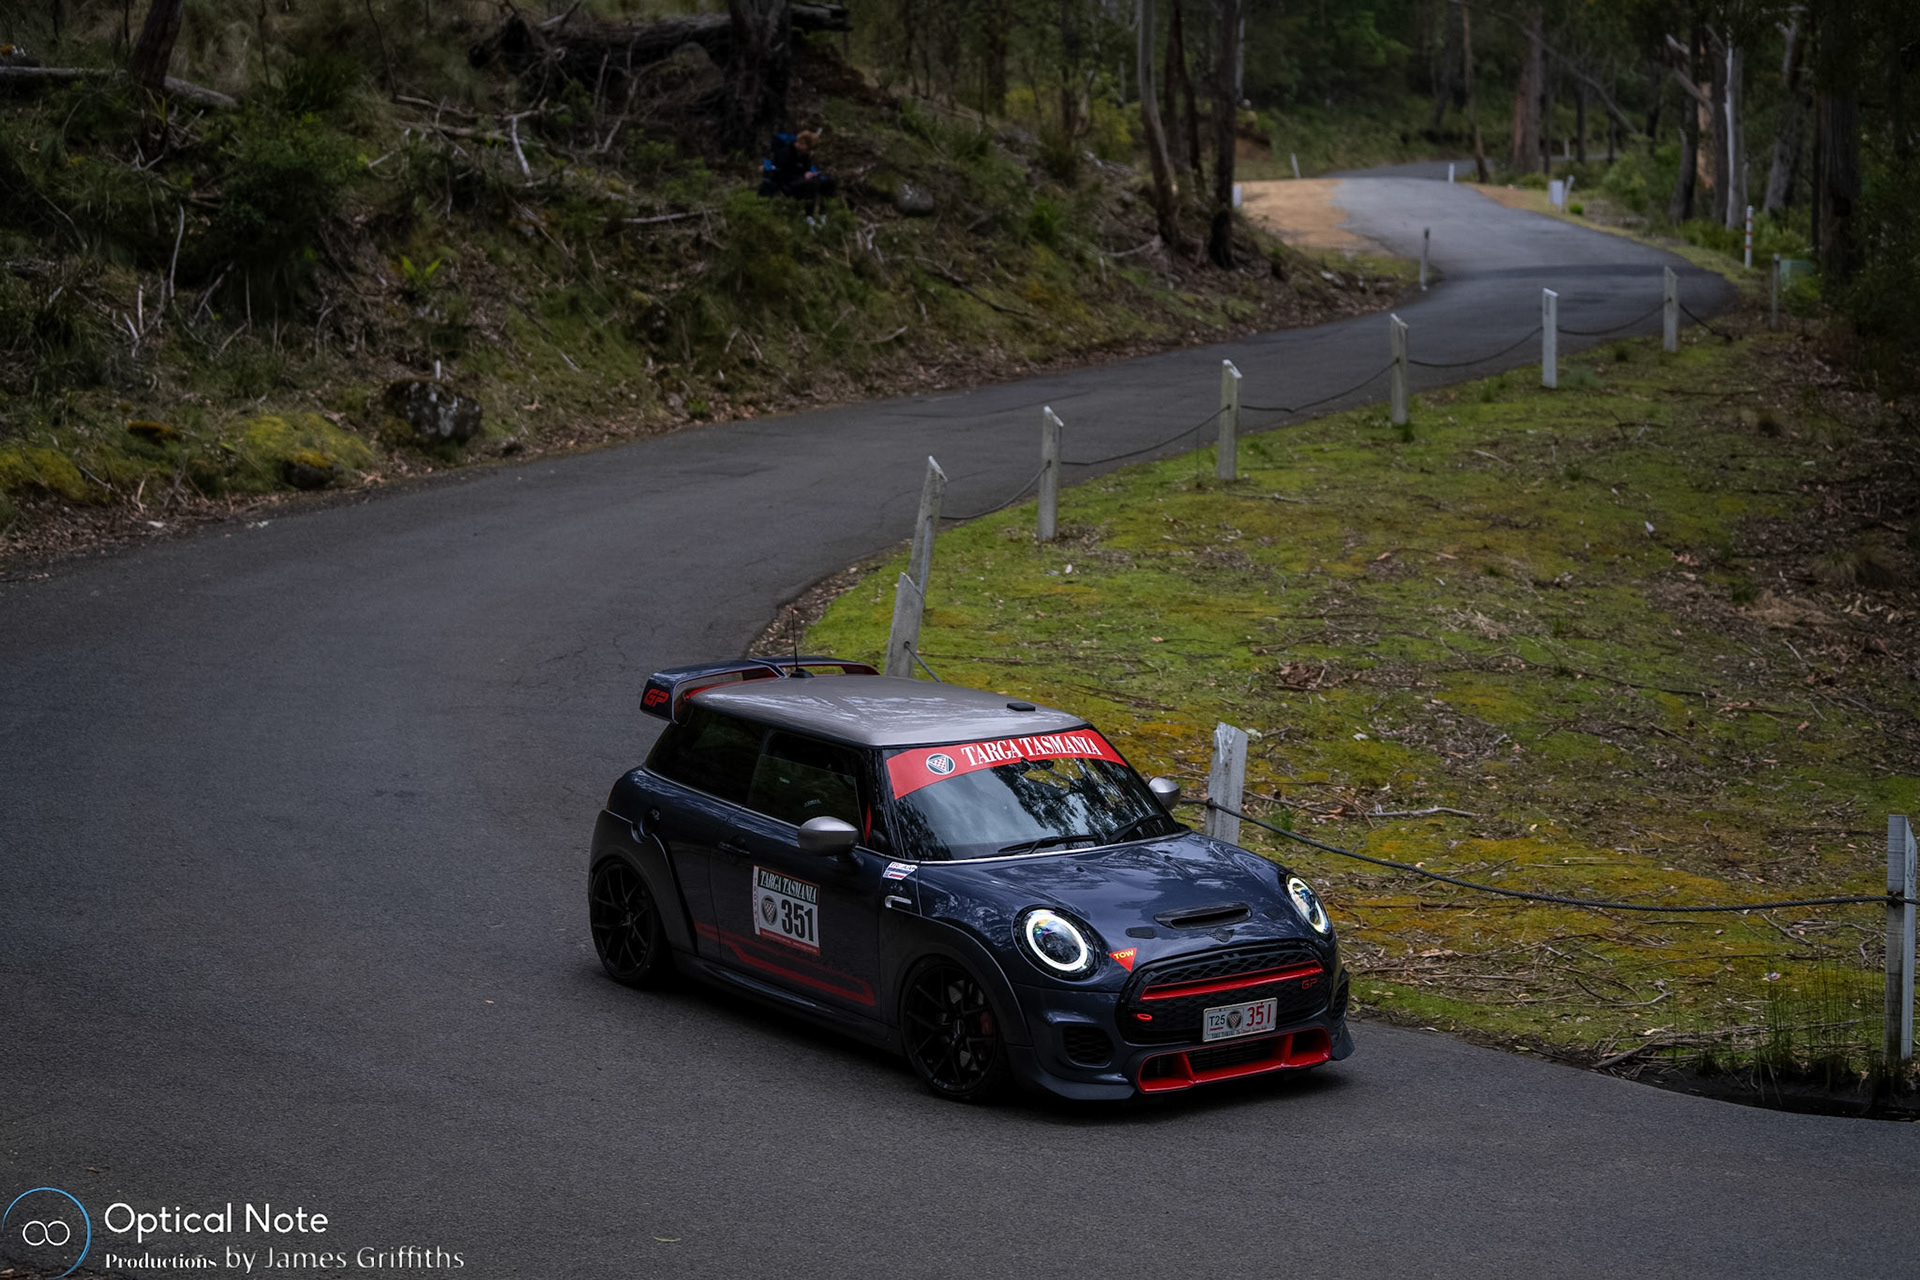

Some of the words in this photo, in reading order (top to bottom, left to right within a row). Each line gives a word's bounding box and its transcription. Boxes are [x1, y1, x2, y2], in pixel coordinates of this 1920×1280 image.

[643, 688, 670, 706] GP
[961, 740, 1024, 768] TARGA
[1019, 735, 1103, 758] TASMANIA
[760, 870, 782, 892] TARGA
[782, 878, 817, 904] TASMANIA
[781, 899, 814, 942] 351
[1113, 949, 1134, 960] TOW
[1301, 978, 1318, 990] GP
[1209, 1014, 1225, 1027] T25
[1246, 1003, 1271, 1027] 351
